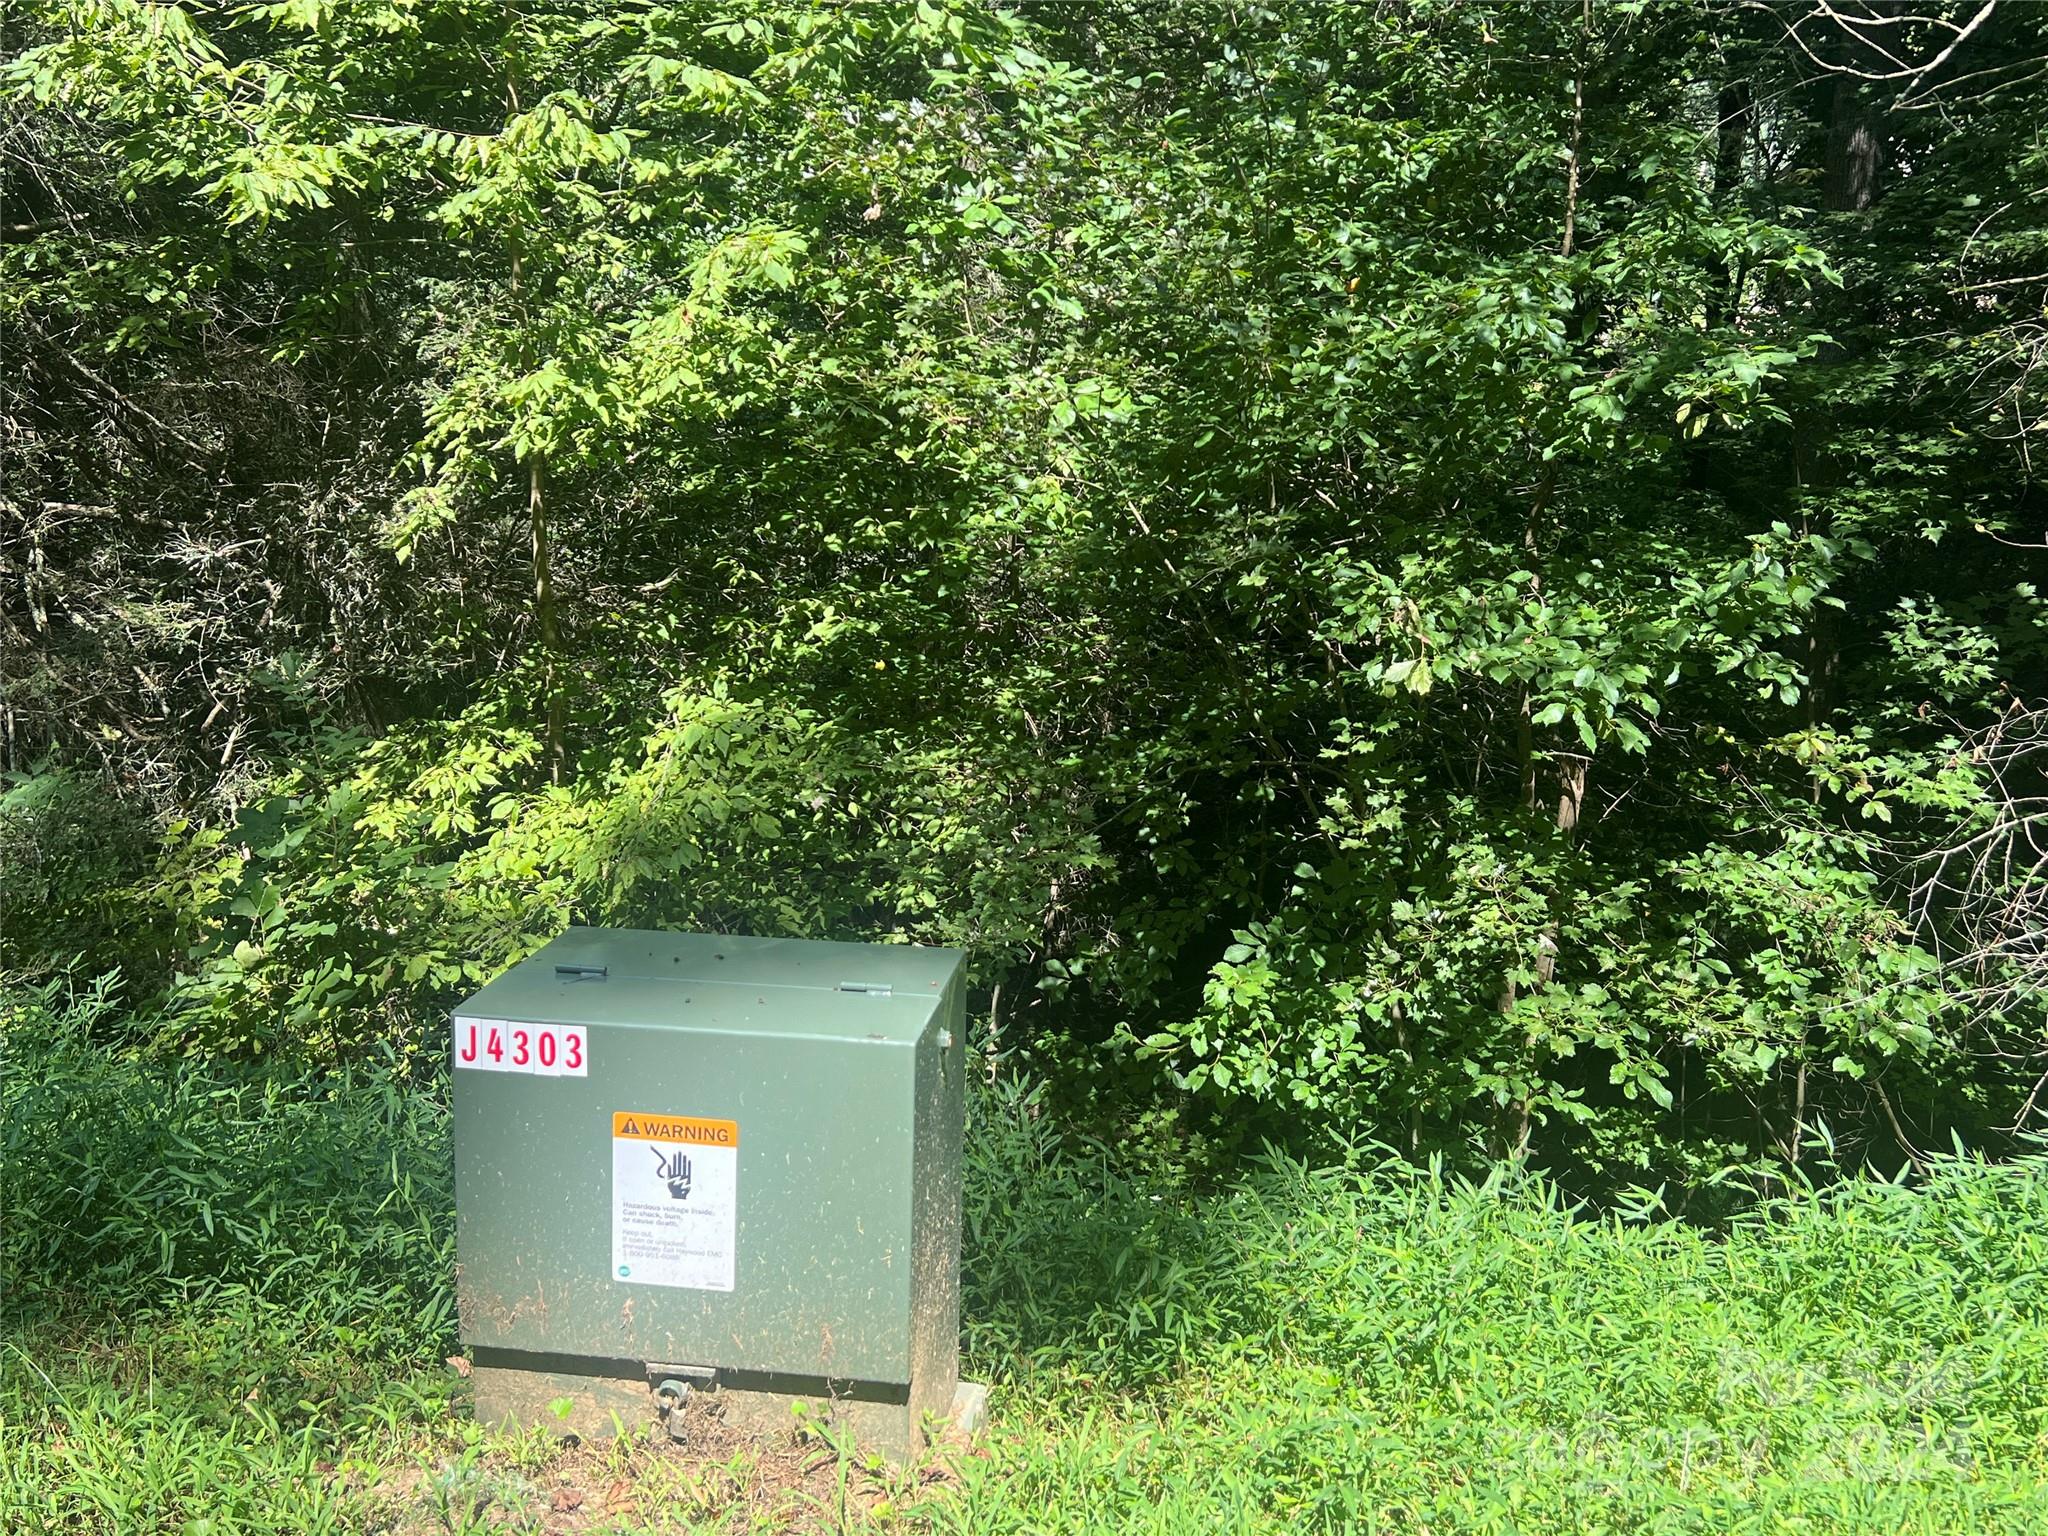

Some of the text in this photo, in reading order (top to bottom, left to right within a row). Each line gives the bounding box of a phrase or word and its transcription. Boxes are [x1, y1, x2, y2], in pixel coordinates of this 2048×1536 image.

[461, 1025, 583, 1069] J4303
[643, 1121, 730, 1143] WARNING
[622, 1201, 661, 1211] Hazardous
[662, 1205, 689, 1215] voltage
[632, 1217, 654, 1225] cause
